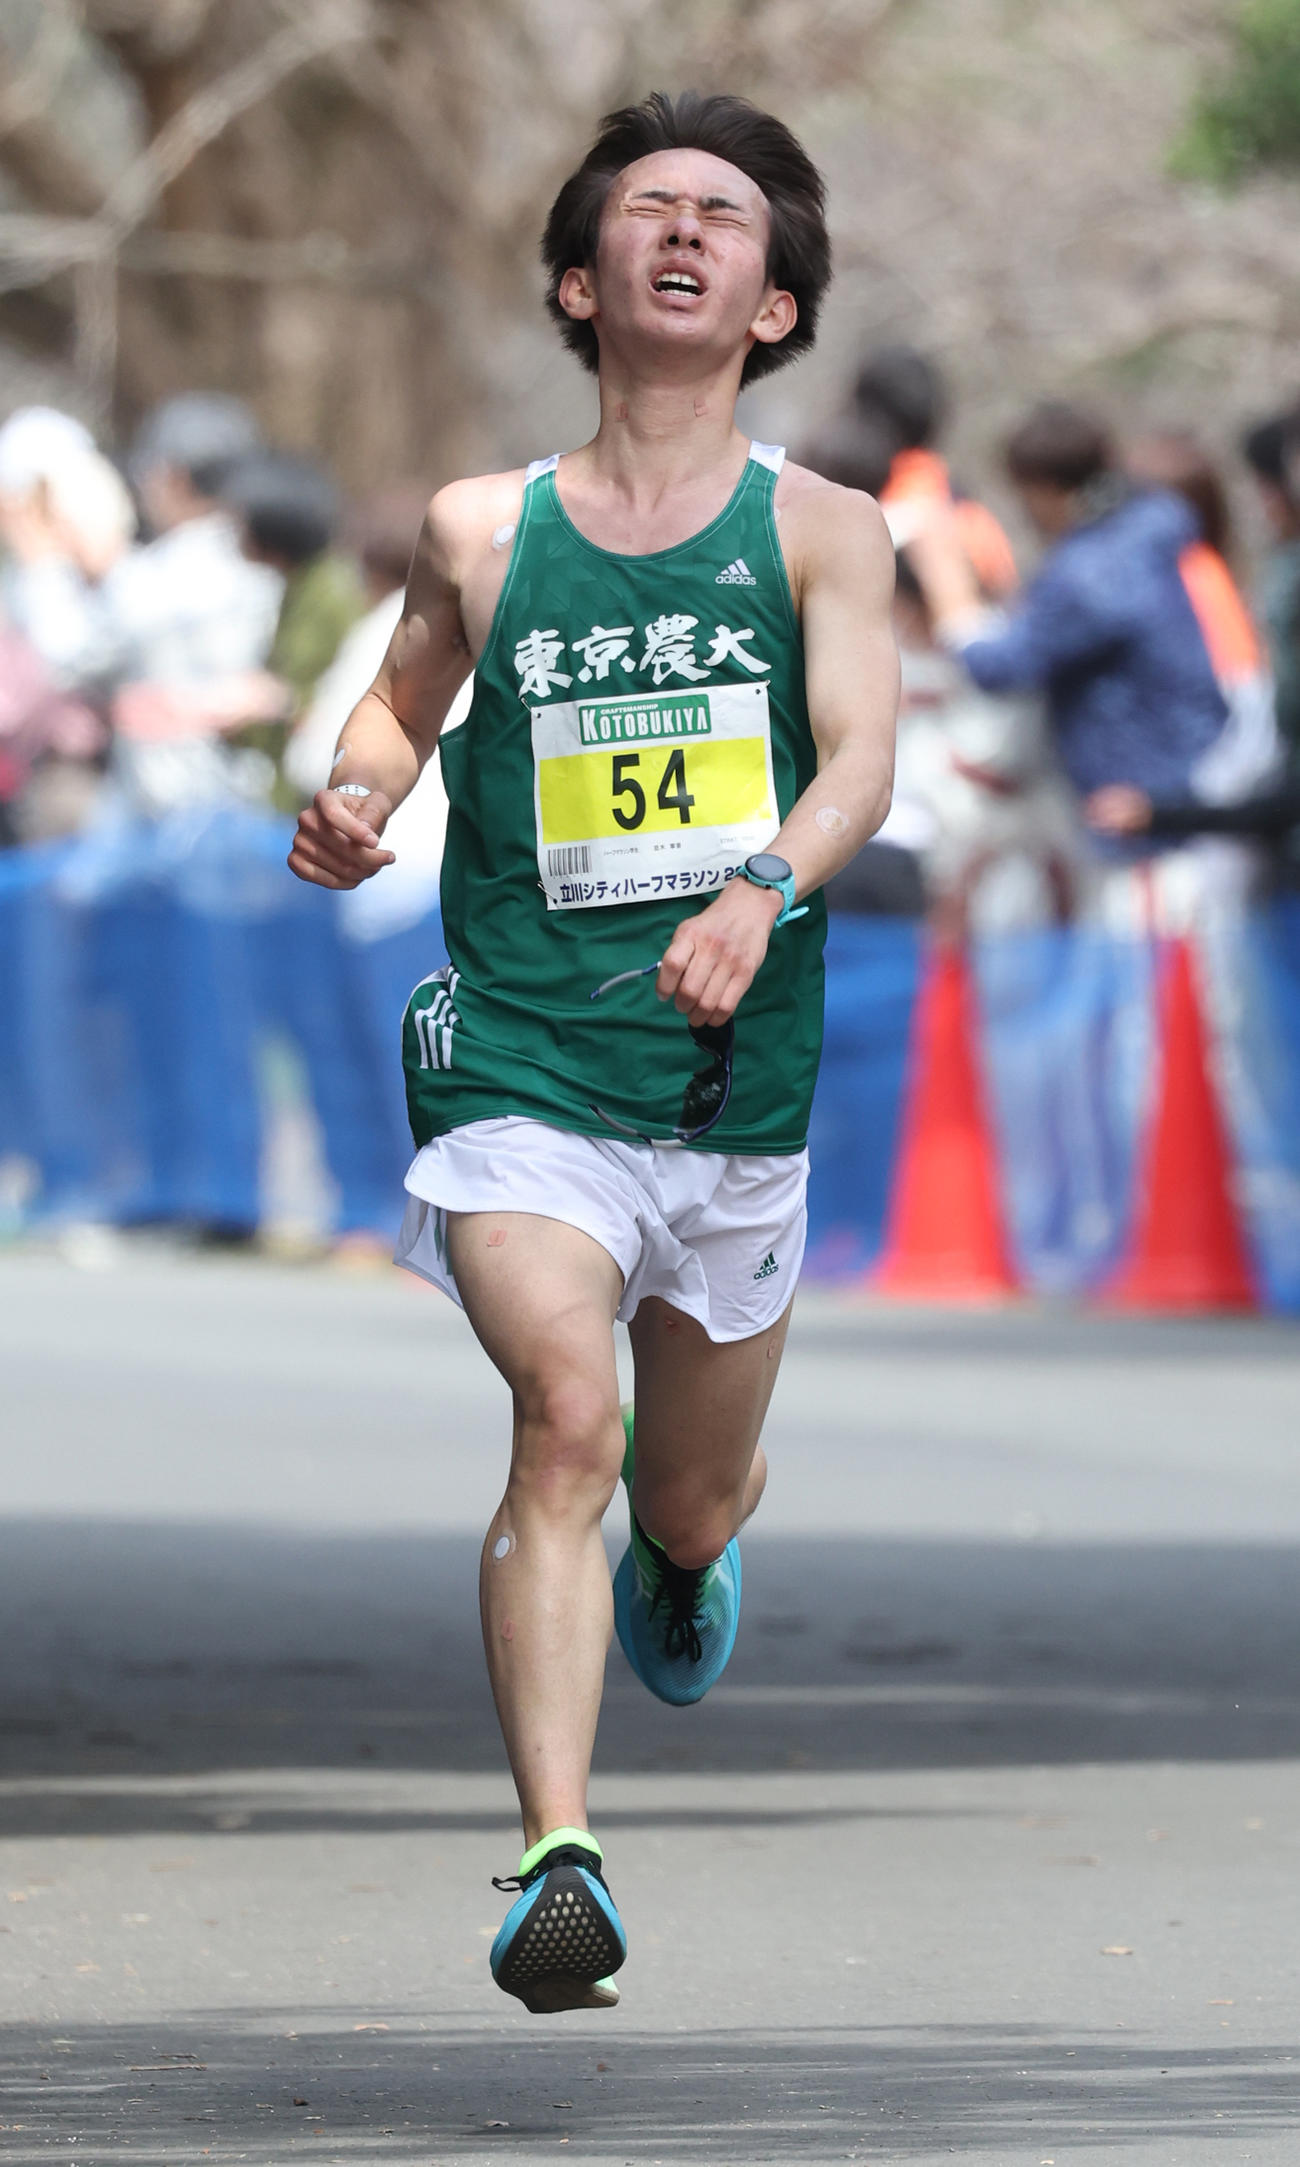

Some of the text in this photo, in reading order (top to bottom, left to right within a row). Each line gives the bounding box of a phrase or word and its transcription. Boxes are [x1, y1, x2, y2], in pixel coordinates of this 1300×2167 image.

[714, 574, 757, 586] adidas
[513, 613, 772, 699] 東京農大
[581, 706, 708, 742] KOTOBUKIYA
[600, 703, 658, 715] CRAFTSMANSHIP
[612, 749, 695, 830] 54
[560, 870, 720, 903] 立川シティハーフマラソン
